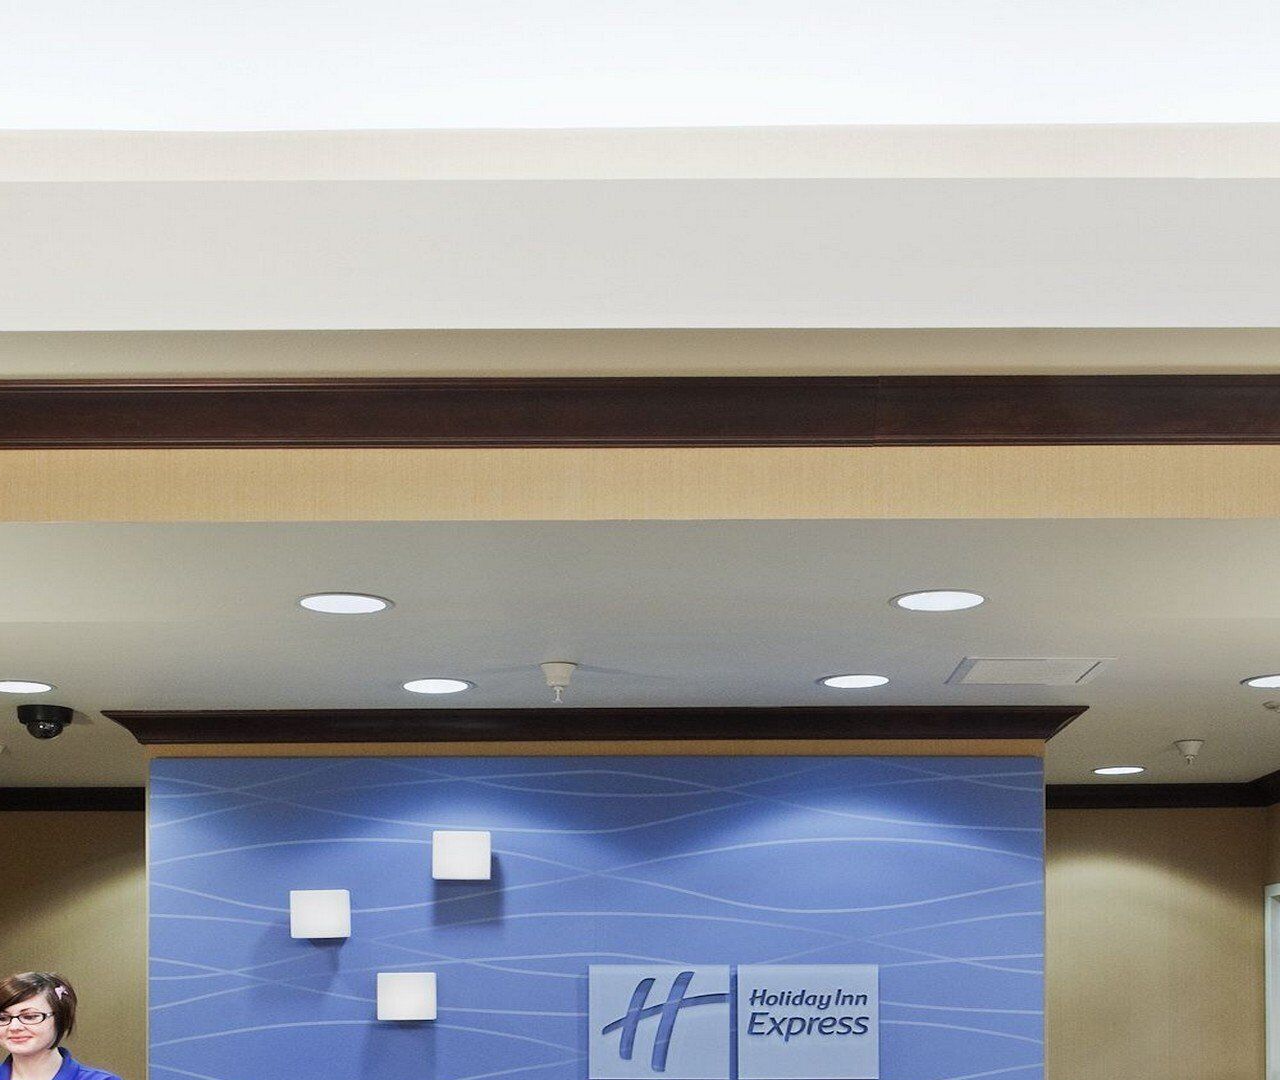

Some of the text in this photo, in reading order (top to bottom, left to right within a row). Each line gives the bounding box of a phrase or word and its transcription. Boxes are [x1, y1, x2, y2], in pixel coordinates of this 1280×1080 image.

[748, 988, 868, 1010] Holiday Inn
[747, 1011, 870, 1042] Express
